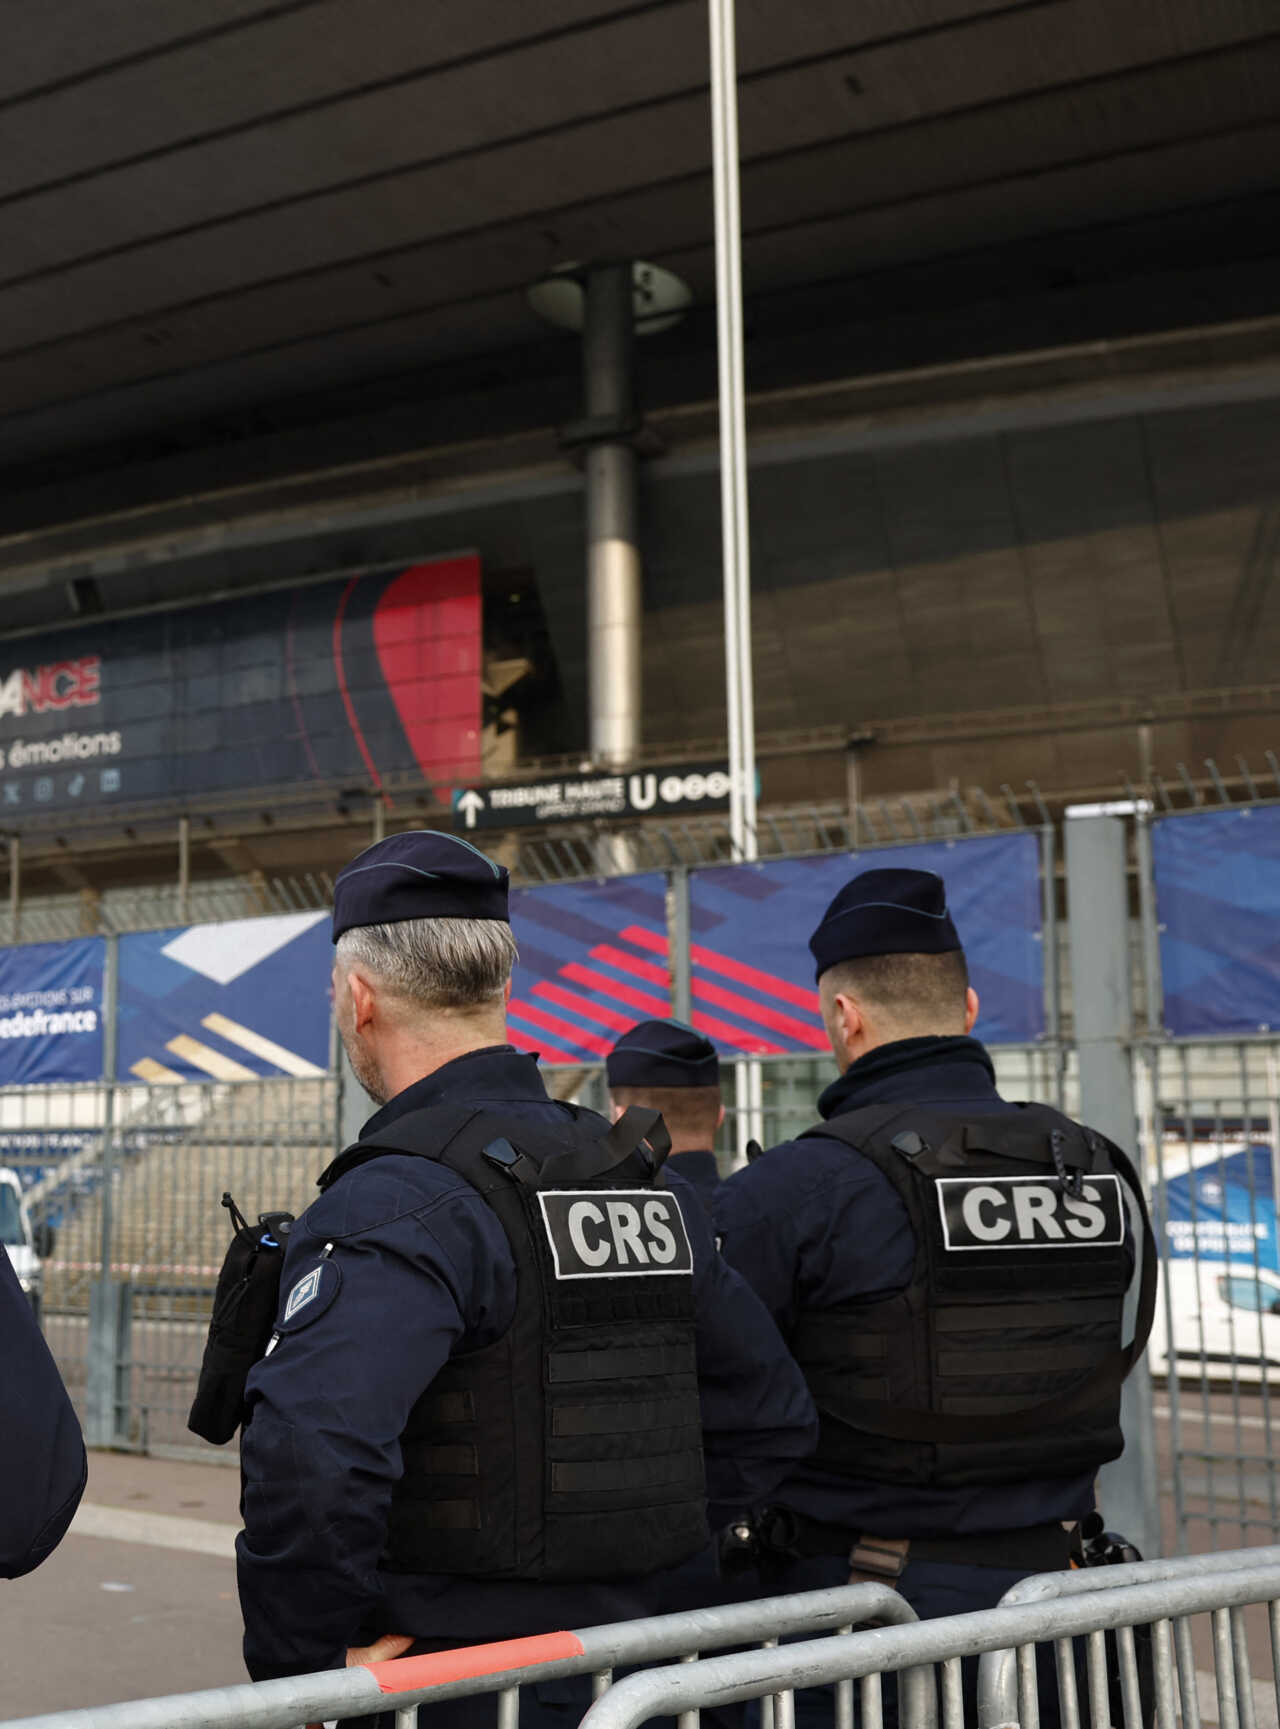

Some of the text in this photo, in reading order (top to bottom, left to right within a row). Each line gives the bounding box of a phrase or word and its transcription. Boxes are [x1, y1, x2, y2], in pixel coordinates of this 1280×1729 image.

[10, 731, 121, 768] émotions
[488, 784, 561, 809] TRIBUNE
[564, 778, 625, 800] HAUTE
[629, 774, 656, 810] U
[70, 986, 94, 1003] SUR
[962, 1185, 1106, 1241] CRS
[568, 1200, 677, 1267] CRS
